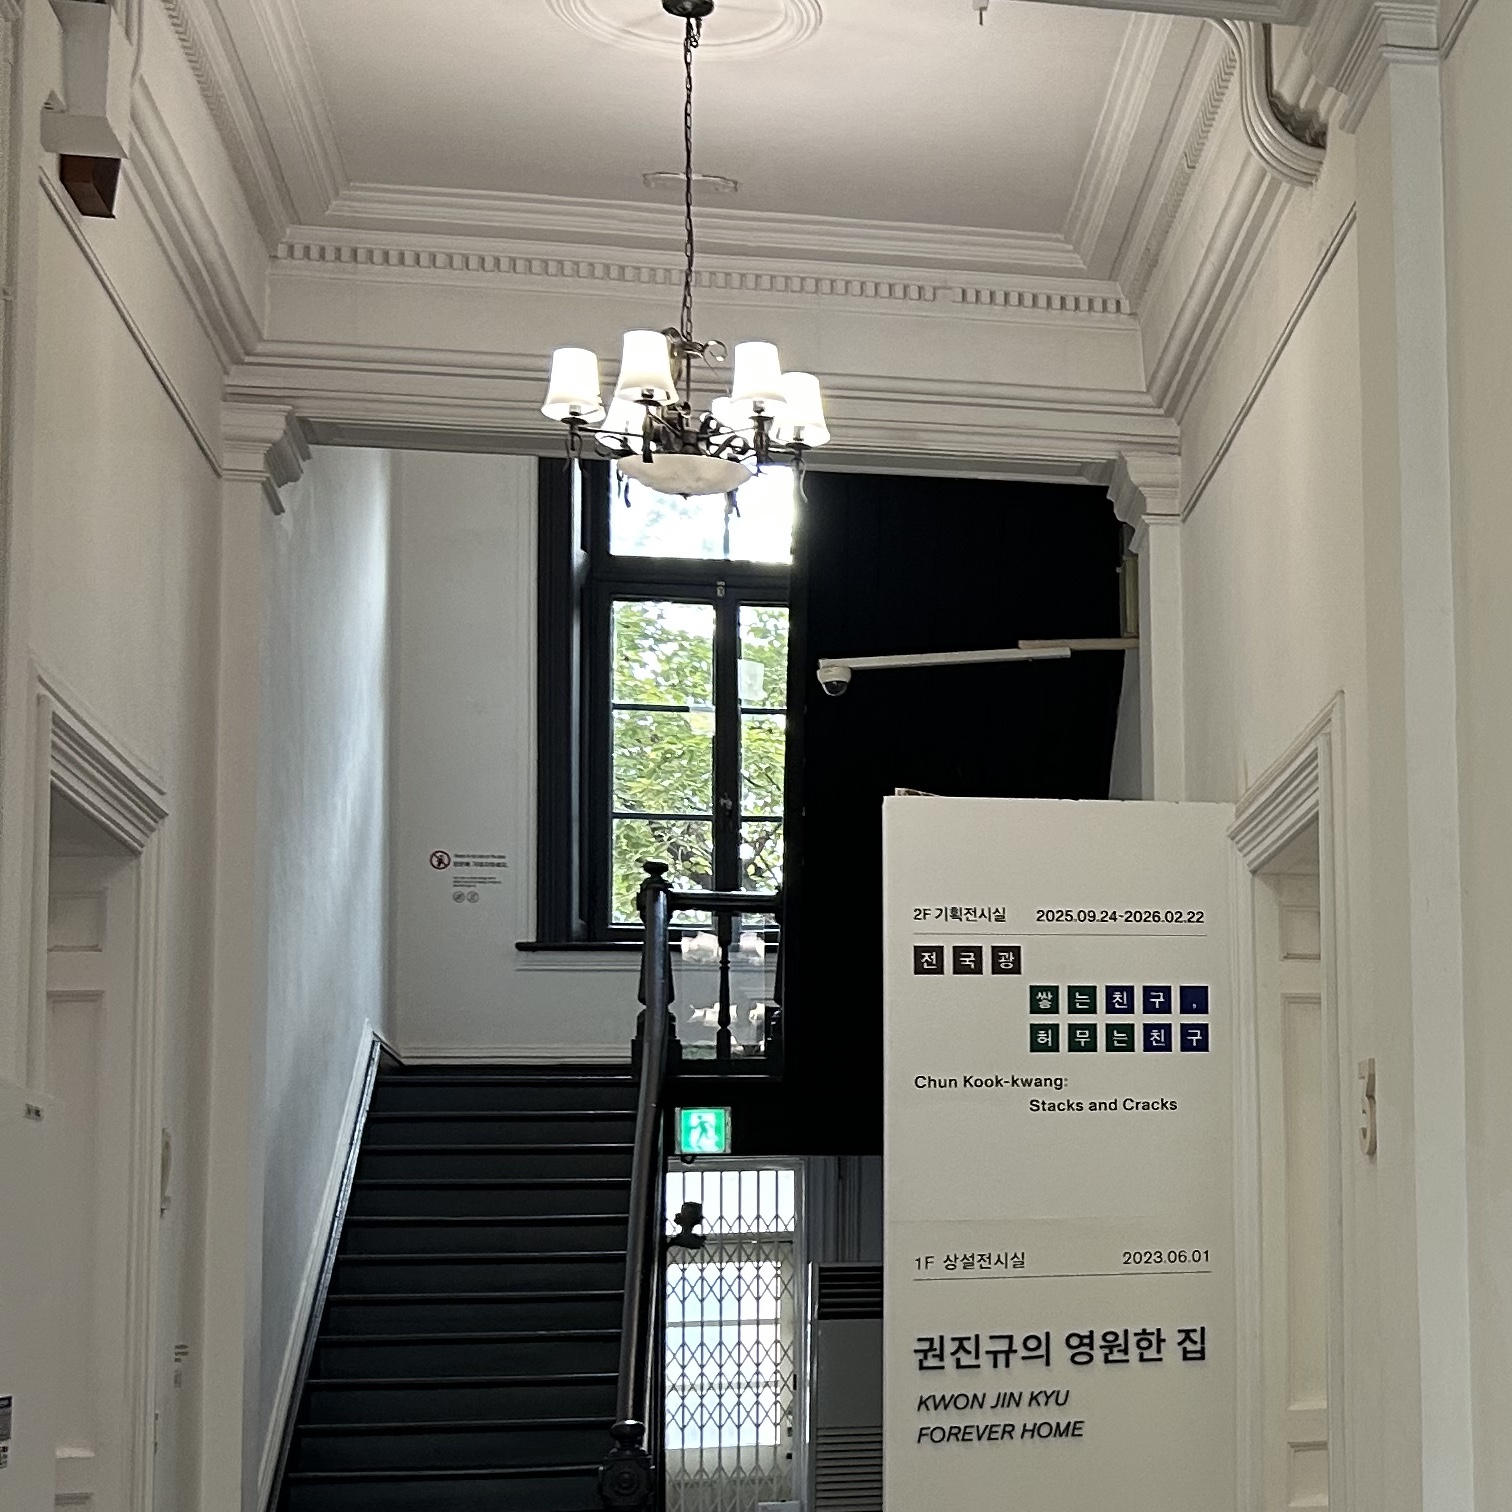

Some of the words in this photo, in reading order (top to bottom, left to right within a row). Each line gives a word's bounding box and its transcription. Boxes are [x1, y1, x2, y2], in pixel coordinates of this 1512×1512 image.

[913, 907, 932, 921] 2F
[934, 906, 1007, 923] 기획전시실
[918, 950, 1017, 972] 전국광
[914, 1075, 958, 1089] Chun
[963, 1075, 1069, 1091] Kook-kwang:
[1029, 1098, 1084, 1113] Stacks
[1088, 1098, 1119, 1112] and
[1122, 1097, 1178, 1111] Cracks
[914, 1255, 935, 1271] 1F
[942, 1251, 1027, 1271] 상설전시실
[1122, 1249, 1210, 1266] 2023.06.01
[913, 1331, 1052, 1372] 권진규의
[1064, 1327, 1167, 1367] 영원한
[1176, 1326, 1207, 1363] 집
[917, 1392, 986, 1413] KWON
[990, 1391, 1023, 1410] JIN
[1027, 1389, 1070, 1408] KYU
[917, 1423, 1016, 1444] FOREVER
[1020, 1420, 1085, 1440] HOME
